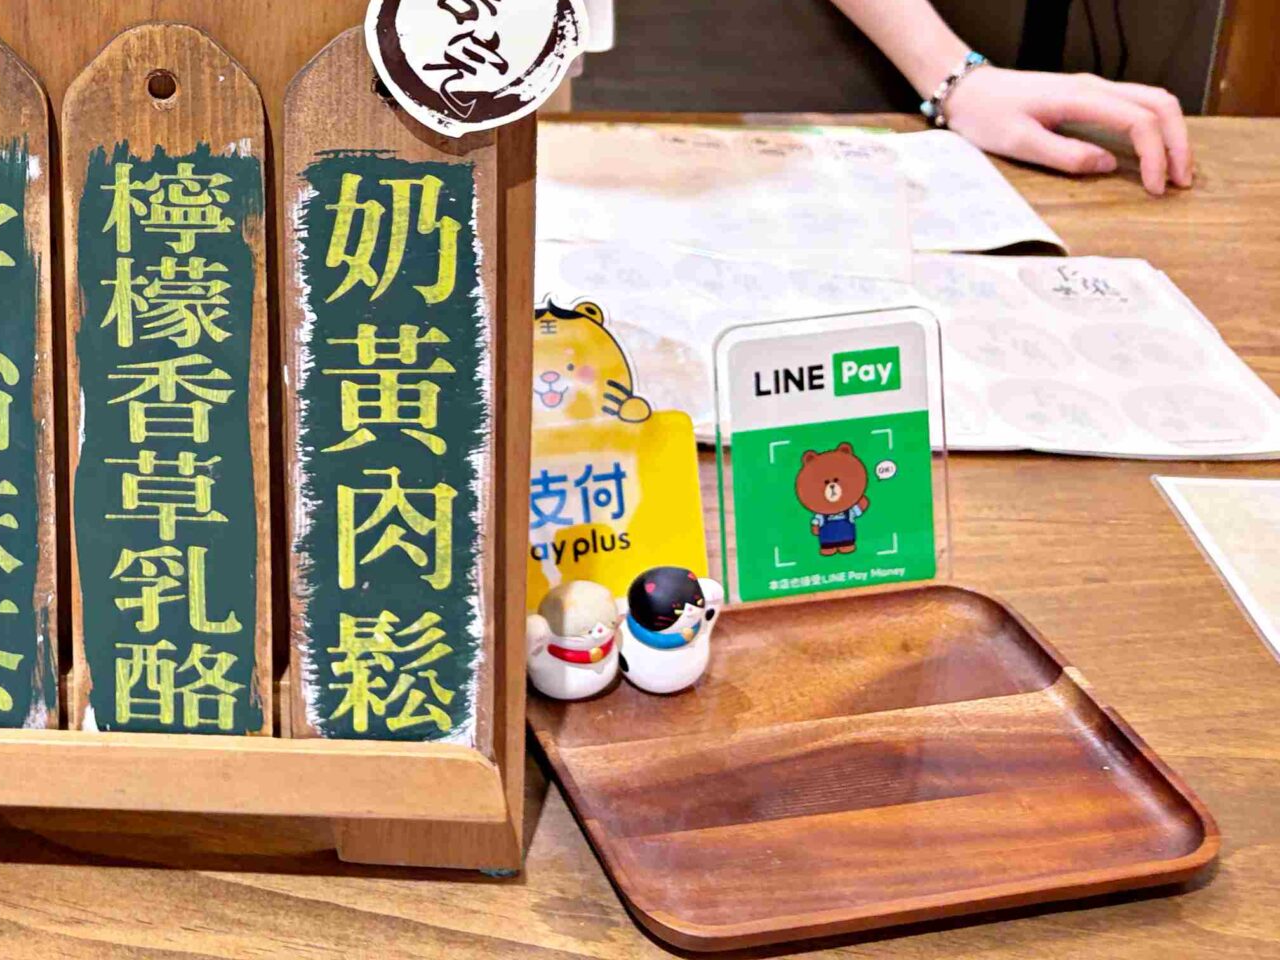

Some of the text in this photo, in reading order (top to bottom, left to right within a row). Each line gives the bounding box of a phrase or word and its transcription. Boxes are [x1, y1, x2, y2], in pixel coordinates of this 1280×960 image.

[99, 161, 247, 731] 檸檬香草乳酪
[320, 171, 463, 733] 奶黃肉鬆
[754, 360, 893, 396] LINE Pay
[572, 528, 631, 562] plus
